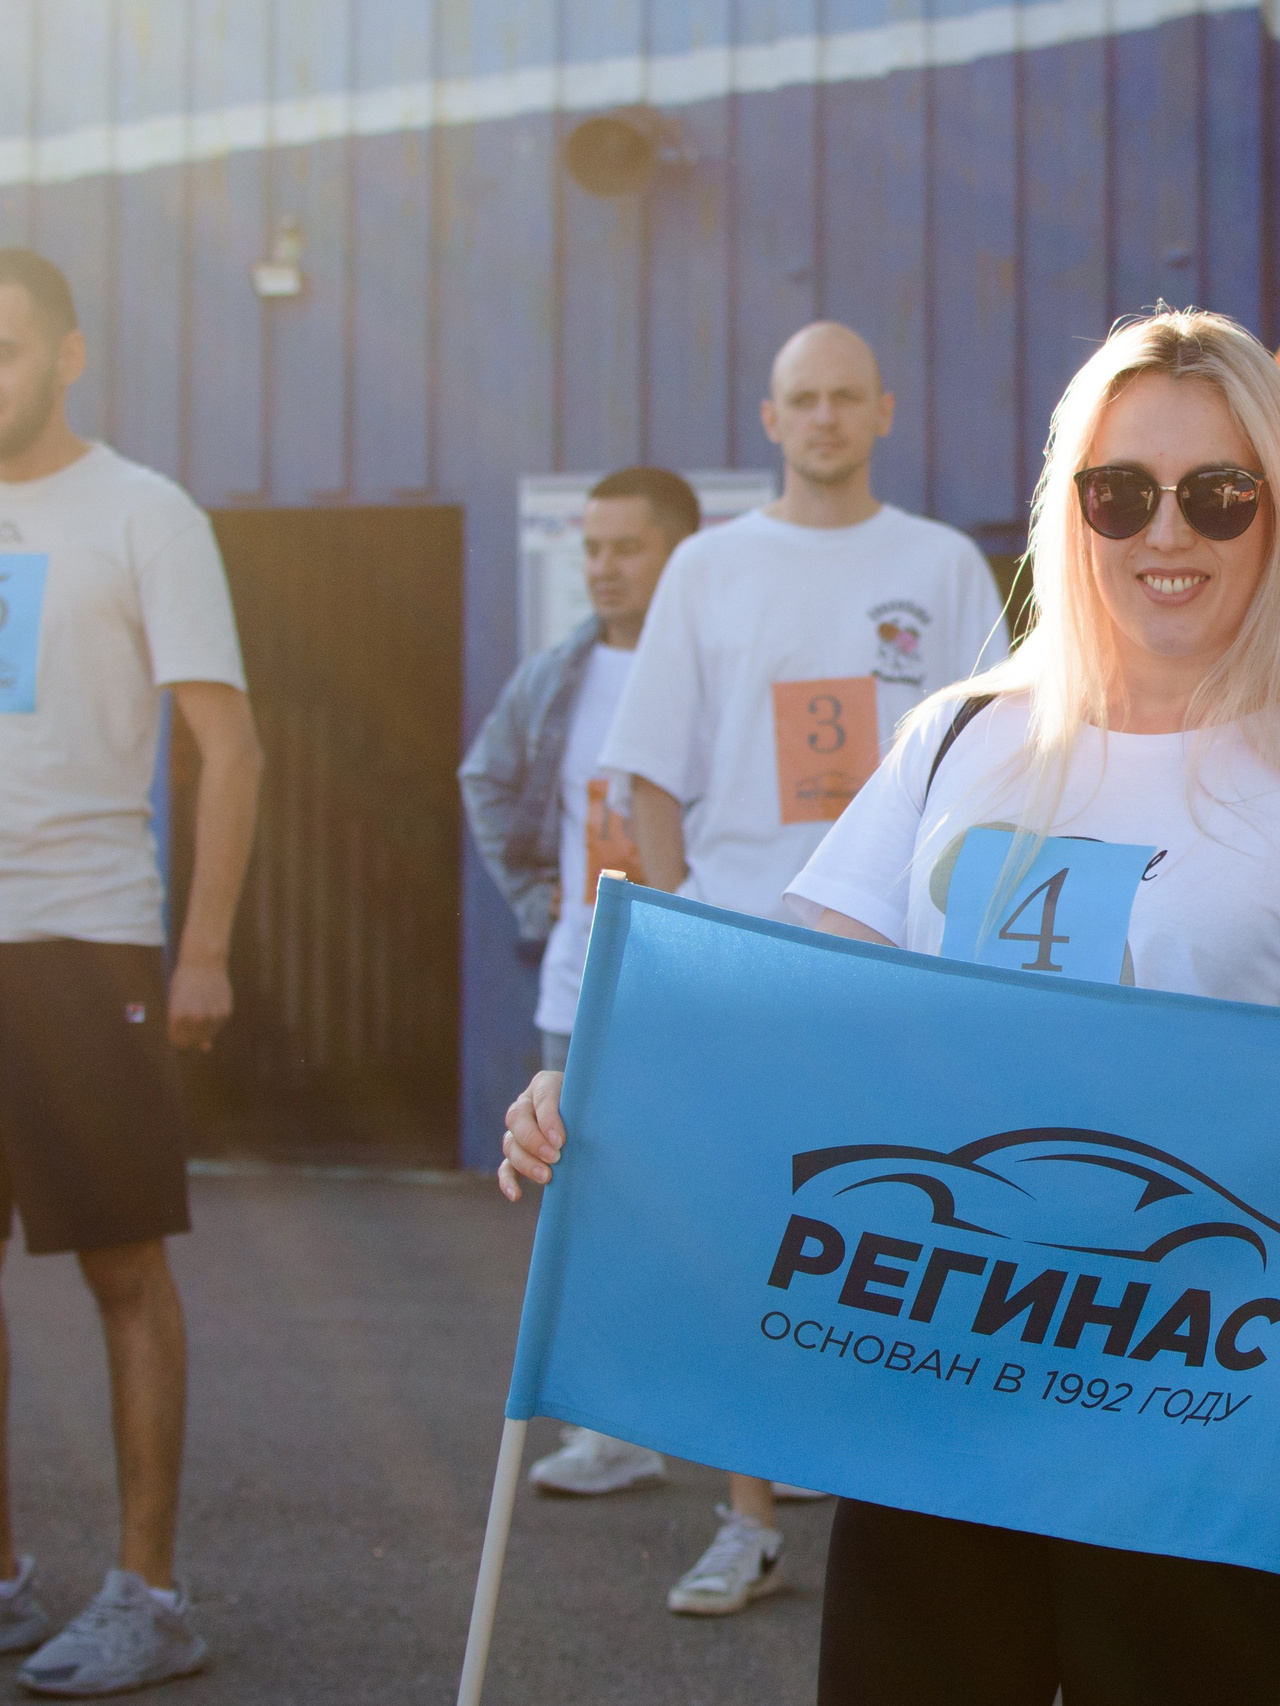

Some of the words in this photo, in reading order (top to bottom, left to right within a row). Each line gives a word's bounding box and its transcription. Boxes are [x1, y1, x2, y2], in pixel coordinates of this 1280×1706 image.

[807, 693, 847, 754] 3
[998, 867, 1070, 973] 4
[760, 1311, 981, 1385] ОСНОВАН
[992, 1362, 1026, 1393] В
[1041, 1370, 1134, 1412] 1992
[1137, 1386, 1252, 1427] ГОДУ
